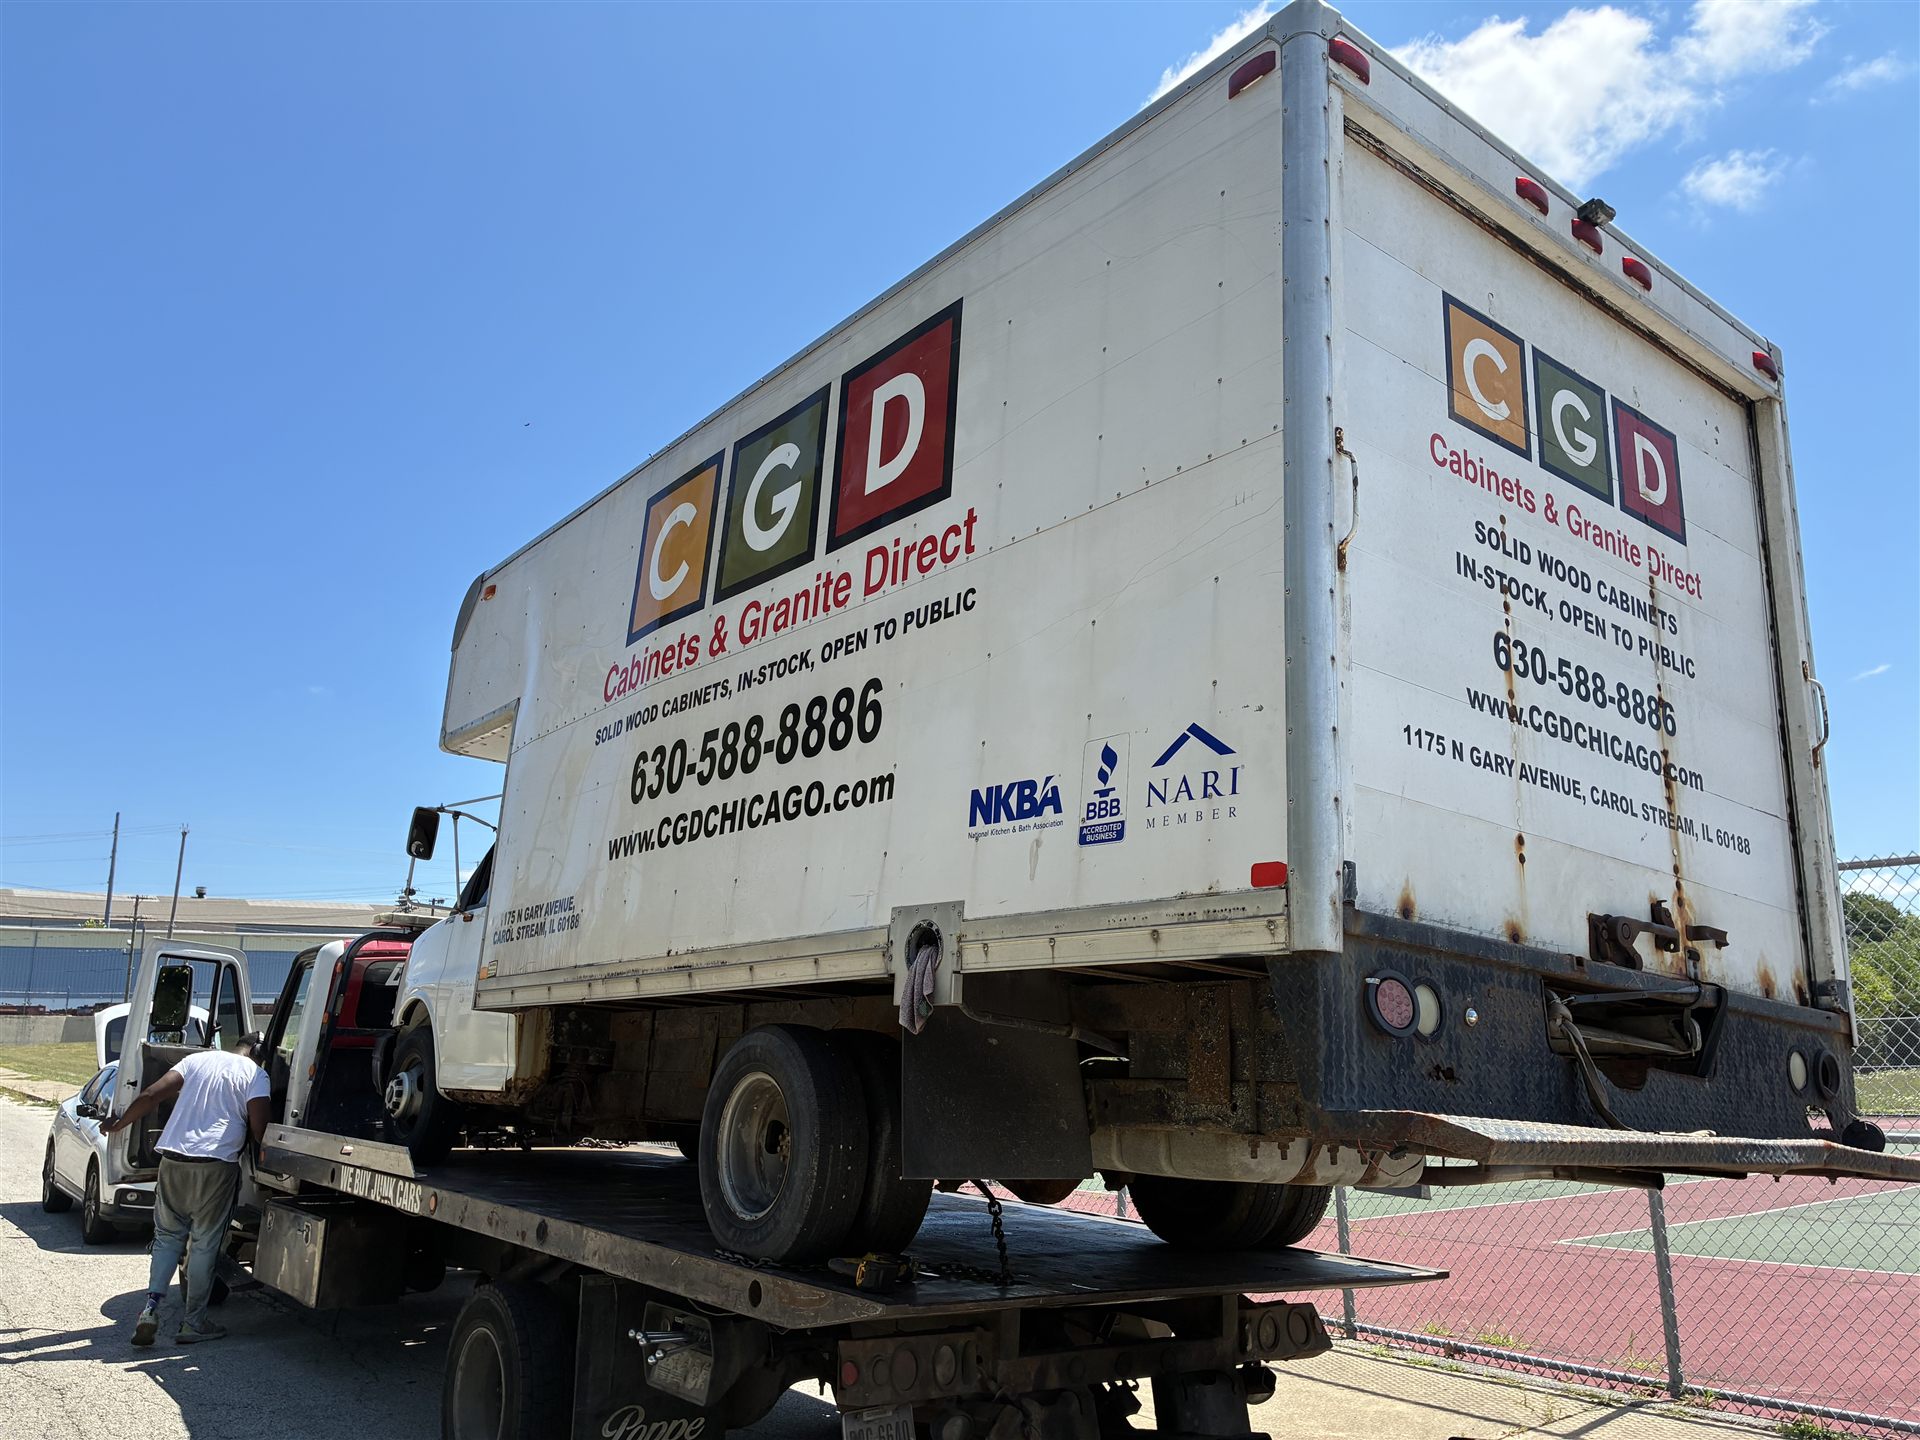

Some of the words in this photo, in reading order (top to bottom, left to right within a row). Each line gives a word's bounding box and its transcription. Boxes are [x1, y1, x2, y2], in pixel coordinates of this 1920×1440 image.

[1430, 433, 1536, 514] Cabinets
[1544, 493, 1560, 526] &
[1566, 505, 1641, 568] Granite
[1648, 545, 1702, 600] Direct
[603, 633, 700, 703] Cabinets
[709, 615, 728, 657] &
[739, 571, 852, 646] Granite
[863, 507, 978, 597] Direct
[1475, 520, 1531, 566] SOLID
[1537, 552, 1592, 595] WOOD
[1597, 580, 1678, 635] CABINETS
[1456, 551, 1553, 620] IN-STOCK,
[1560, 601, 1606, 640] OPEN
[1611, 623, 1633, 651] TO
[1639, 636, 1696, 679] PUBLIC
[595, 719, 622, 746] SOLID
[626, 700, 659, 733] WOOD
[662, 679, 732, 718] CABINETS,
[737, 649, 815, 693] IN-STOCK,
[821, 628, 867, 664] OPEN
[873, 617, 897, 645] TO
[903, 587, 977, 634] PUBLIC
[1493, 631, 1677, 737] 630-588-8886
[630, 677, 883, 805] 630-588-8886
[1466, 687, 1704, 791] www.CGDCHICAGOcom
[608, 772, 895, 861] www.CGDCHICAGO.com
[969, 775, 1063, 827] NKBA
[1086, 798, 1121, 821] BBB
[1146, 767, 1240, 808] NARI
[1146, 806, 1237, 829] MEMBER
[1403, 724, 1446, 756] 1175
[1452, 740, 1464, 762] N
[1470, 746, 1515, 778] GARY
[1519, 763, 1586, 805] AVENUE,
[1590, 786, 1638, 818] CAROL
[1642, 803, 1699, 842] STREAM,
[1702, 823, 1713, 843] IL
[1716, 829, 1751, 855] 60188
[968, 830, 989, 840] National
[991, 827, 1010, 837] Kitchen
[1012, 825, 1017, 833] &
[1019, 823, 1031, 832] Bath
[1032, 819, 1063, 830] Association
[1082, 823, 1122, 835] ACCREDITED
[1085, 831, 1117, 842] BUSINESS
[493, 927, 514, 945] CAROL
[516, 921, 547, 939] STREAM,
[549, 920, 555, 934] IL
[557, 913, 580, 932] 60188
[517, 909, 522, 923] N
[524, 903, 544, 921] GARY
[544, 896, 575, 916] AVENUE,
[340, 1164, 352, 1192] WE
[354, 1168, 371, 1196] BUY
[371, 1173, 396, 1204] JUNK
[397, 1180, 422, 1214] CARS
